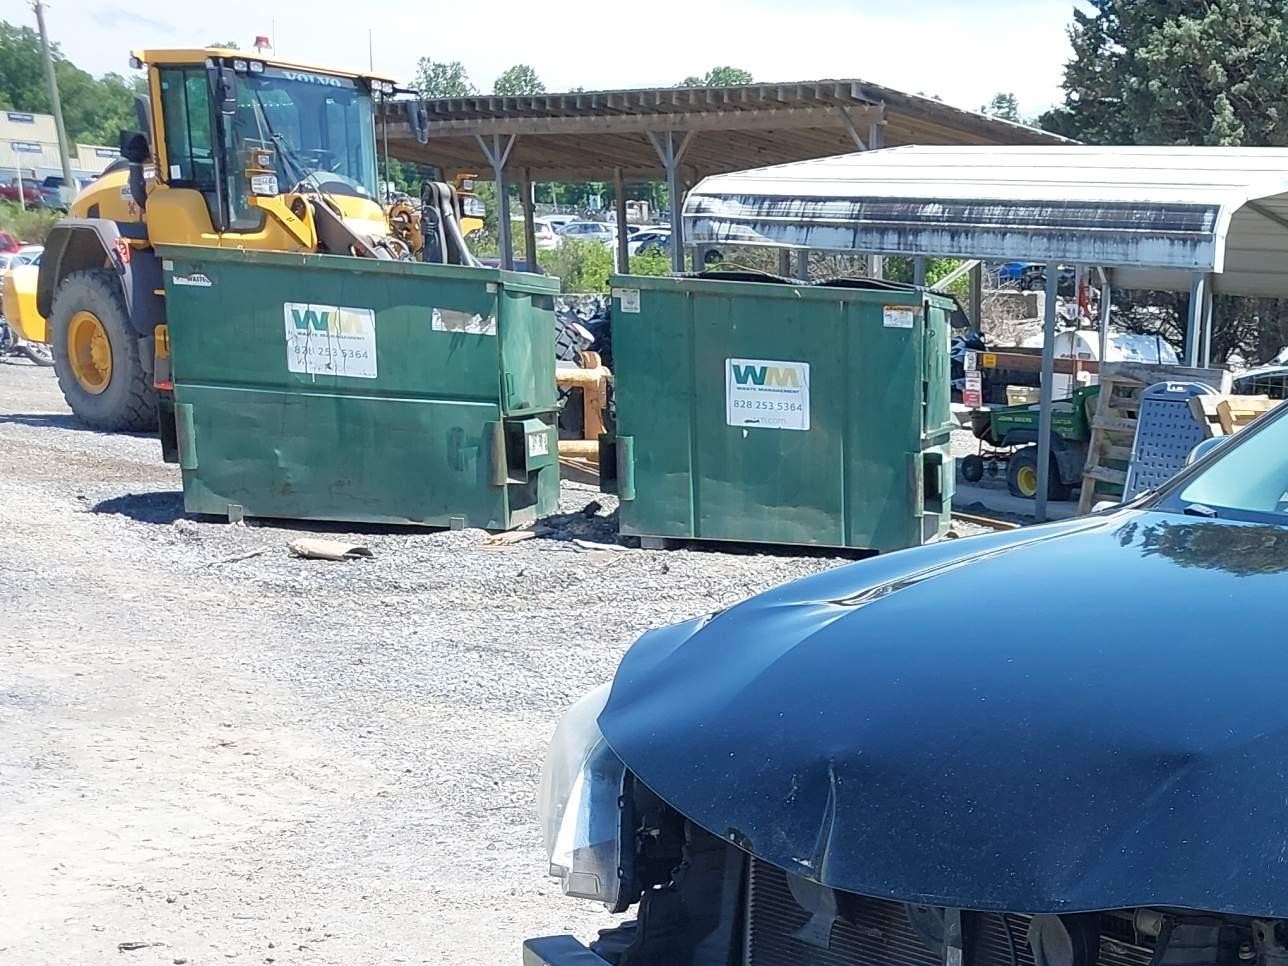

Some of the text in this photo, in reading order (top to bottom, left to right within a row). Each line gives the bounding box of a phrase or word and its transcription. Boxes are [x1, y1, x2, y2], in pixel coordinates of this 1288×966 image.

[318, 346, 338, 357] 253
[341, 349, 369, 359] 5364
[732, 365, 800, 387] WM
[733, 399, 802, 411] 828 253 5364
